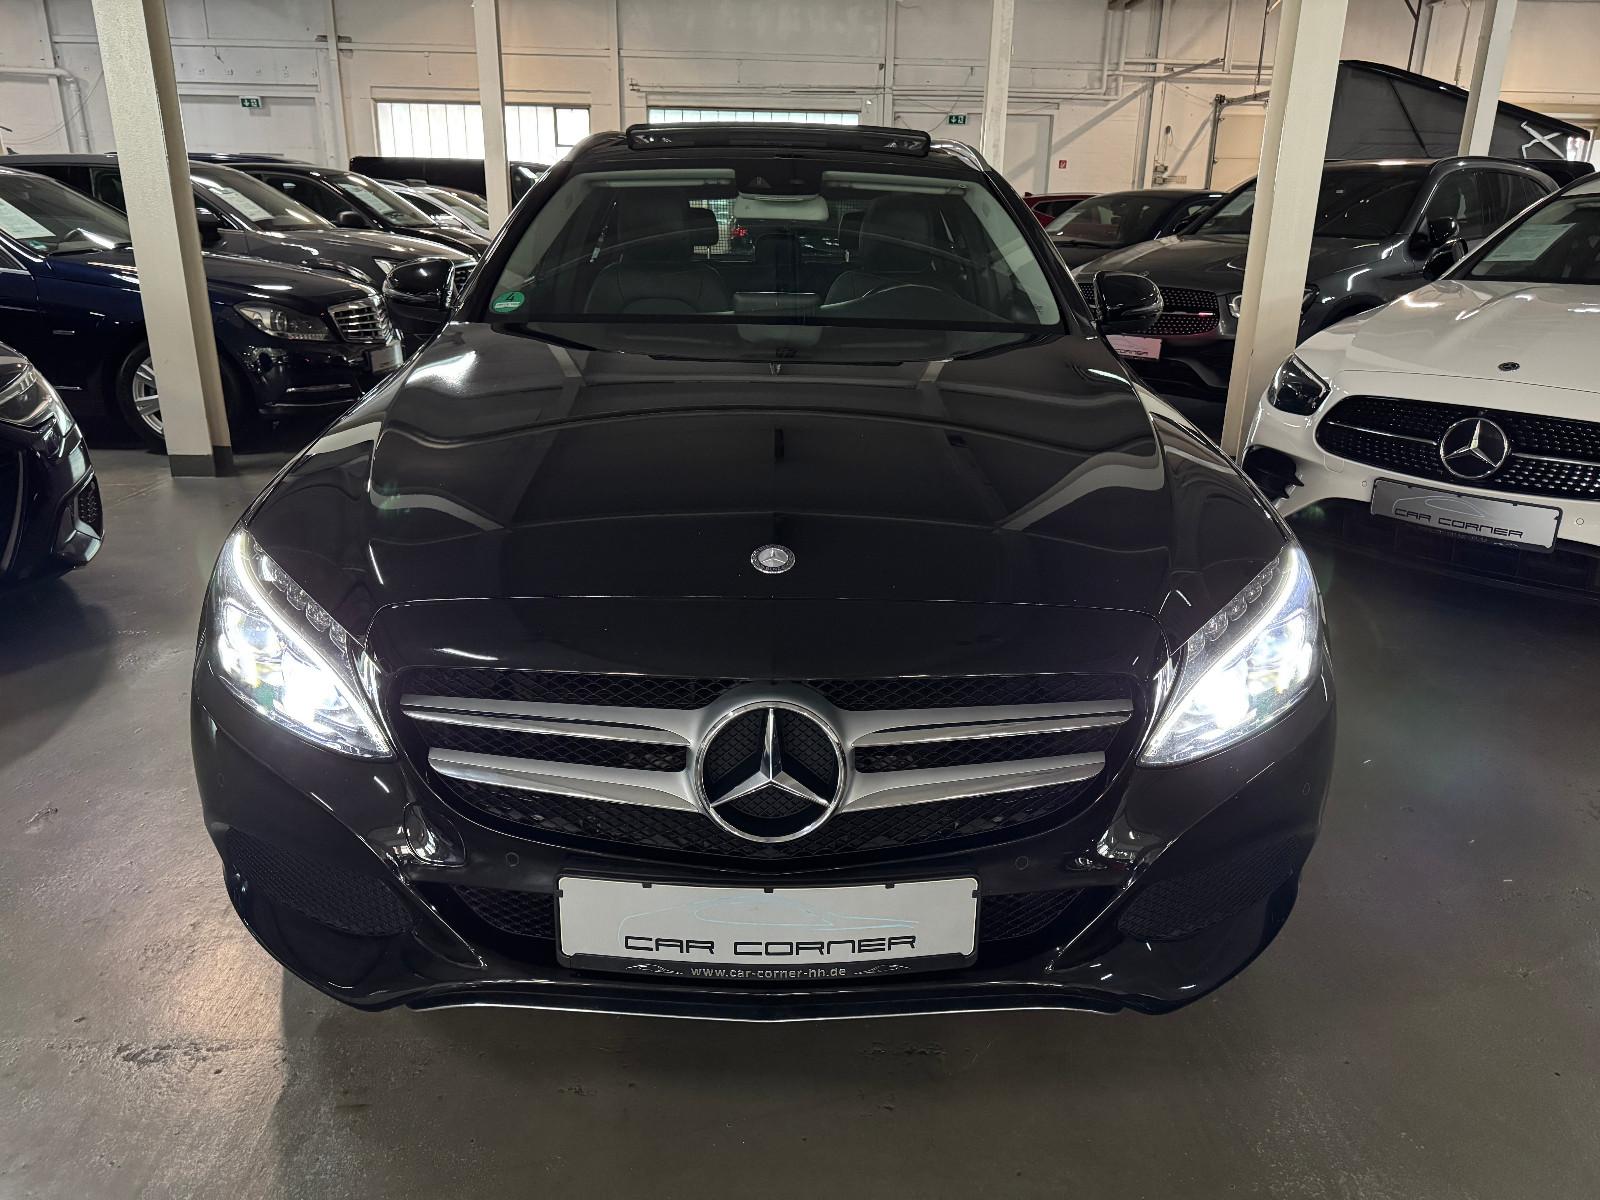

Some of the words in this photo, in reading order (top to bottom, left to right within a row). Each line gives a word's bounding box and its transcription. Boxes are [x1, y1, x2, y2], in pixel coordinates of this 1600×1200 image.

[505, 292, 515, 302] 4
[1394, 508, 1432, 522] CAR
[1438, 517, 1524, 539] CORNER
[624, 935, 715, 955] CAR
[733, 935, 917, 956] CORNER
